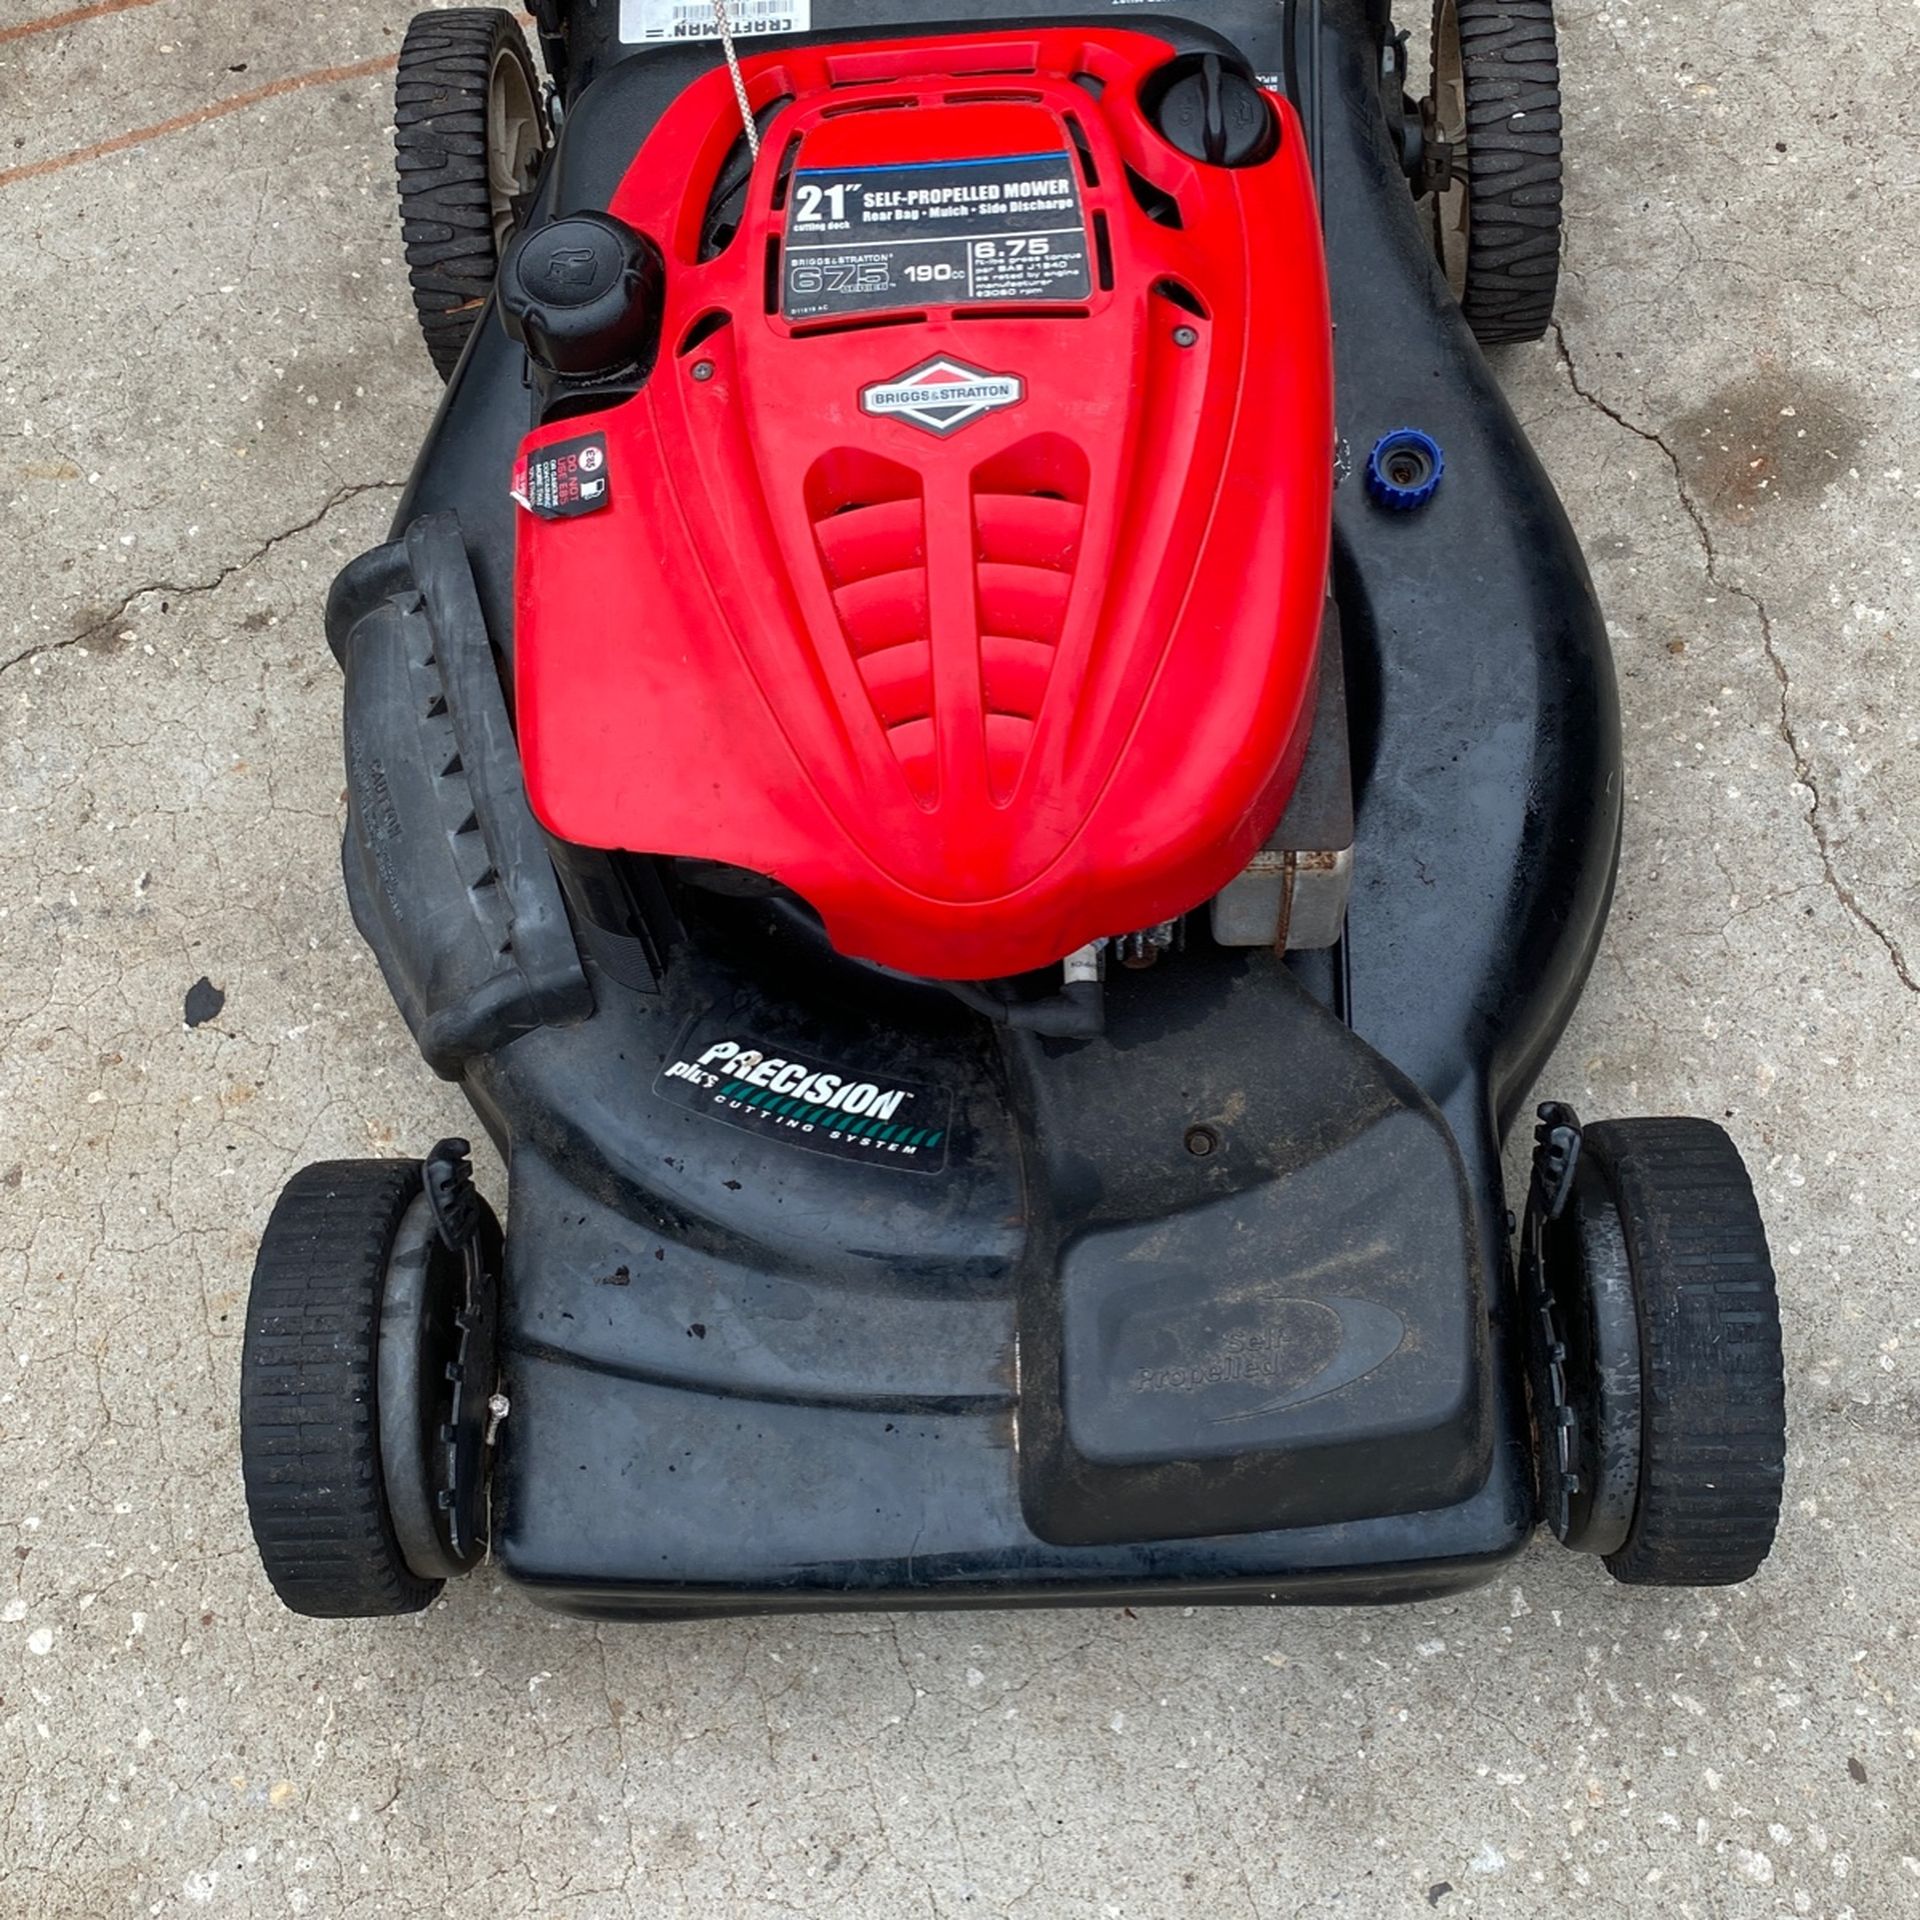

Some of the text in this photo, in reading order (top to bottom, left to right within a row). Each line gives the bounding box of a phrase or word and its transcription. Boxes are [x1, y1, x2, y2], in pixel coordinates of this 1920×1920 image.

[674, 18, 793, 38] CRAFTMAN
[863, 184, 1000, 208] SELF-PROPELLED
[1003, 179, 1070, 199] MOWER
[862, 198, 1074, 222] Rear Bag Mulch Side Discharge
[827, 220, 851, 231] deck
[974, 238, 1050, 259] 6.75
[790, 262, 890, 293] 675
[875, 385, 1010, 405] BRIGGS&STRATTON
[585, 449, 596, 469] E85
[558, 457, 569, 505] USE E85
[567, 454, 579, 501] DO NOT
[664, 1060, 720, 1088] plus
[697, 1041, 905, 1120] PRECISION
[714, 1094, 918, 1155] CUTTING SYSTEM
[1137, 1352, 1279, 1391] Propelled
